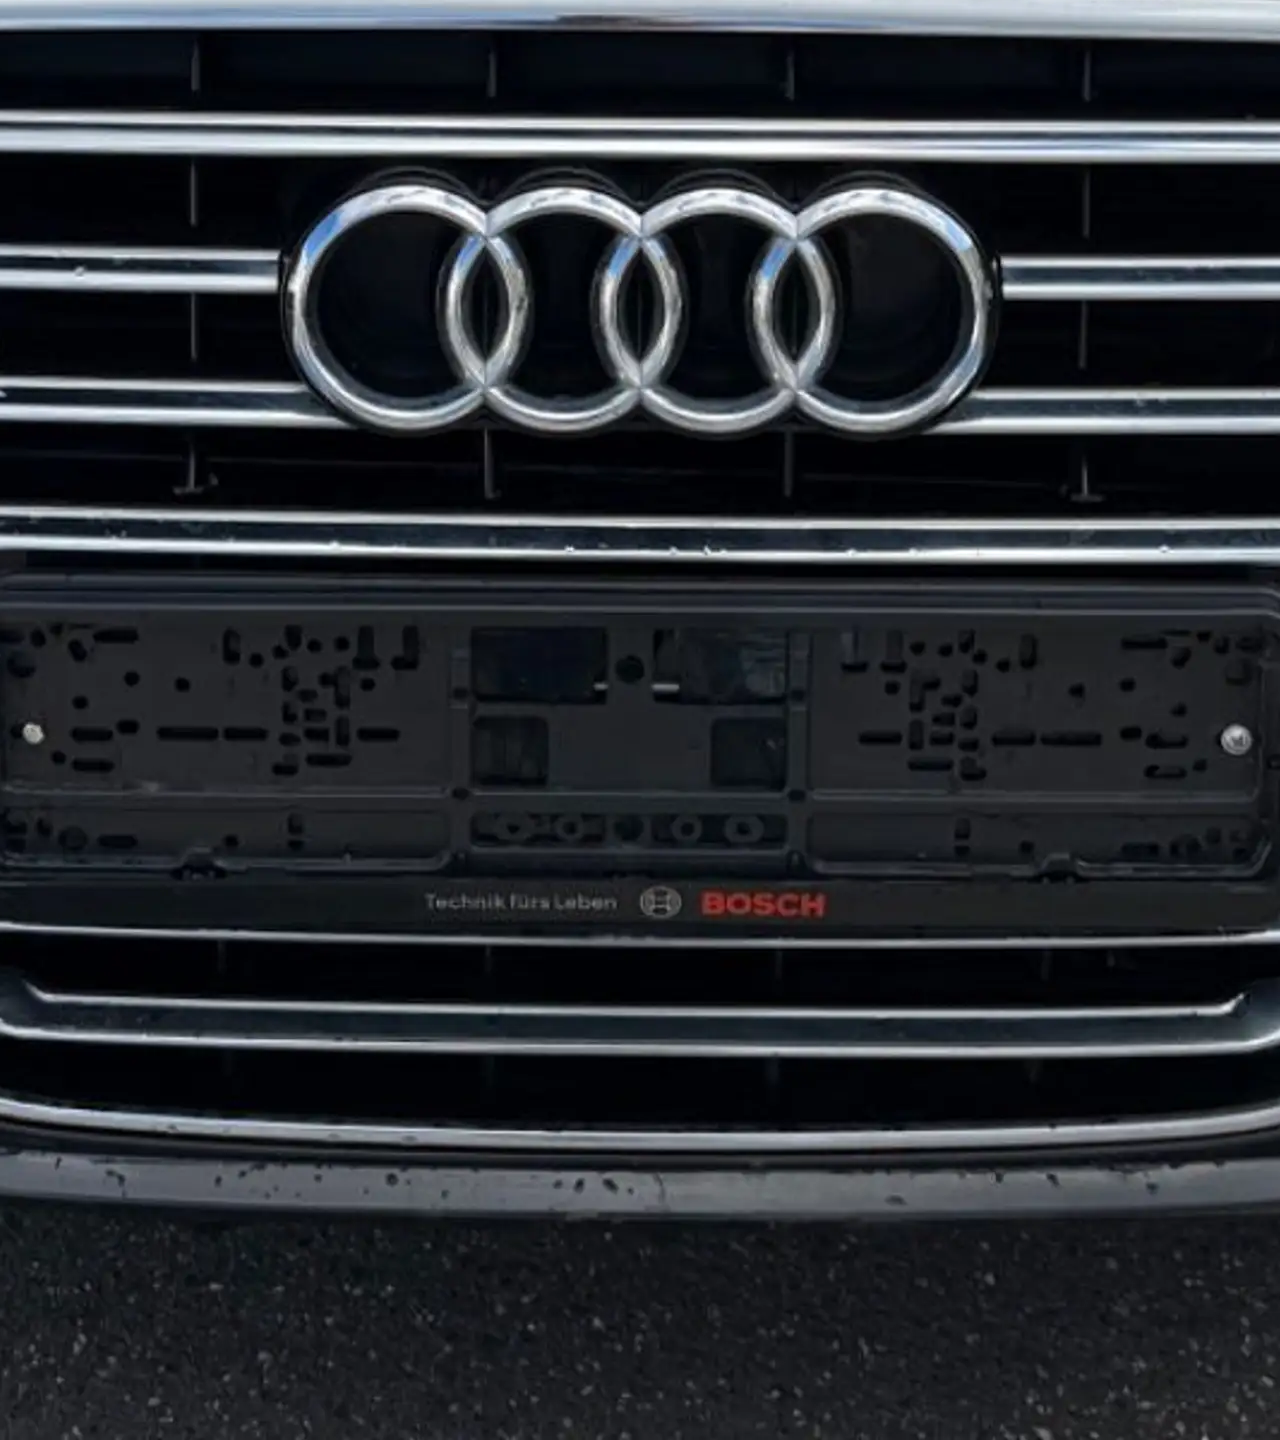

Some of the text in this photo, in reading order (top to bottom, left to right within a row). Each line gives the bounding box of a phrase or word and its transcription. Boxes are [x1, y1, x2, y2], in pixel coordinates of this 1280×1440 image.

[424, 891, 827, 917] Technik fürs Leben BOSCH
